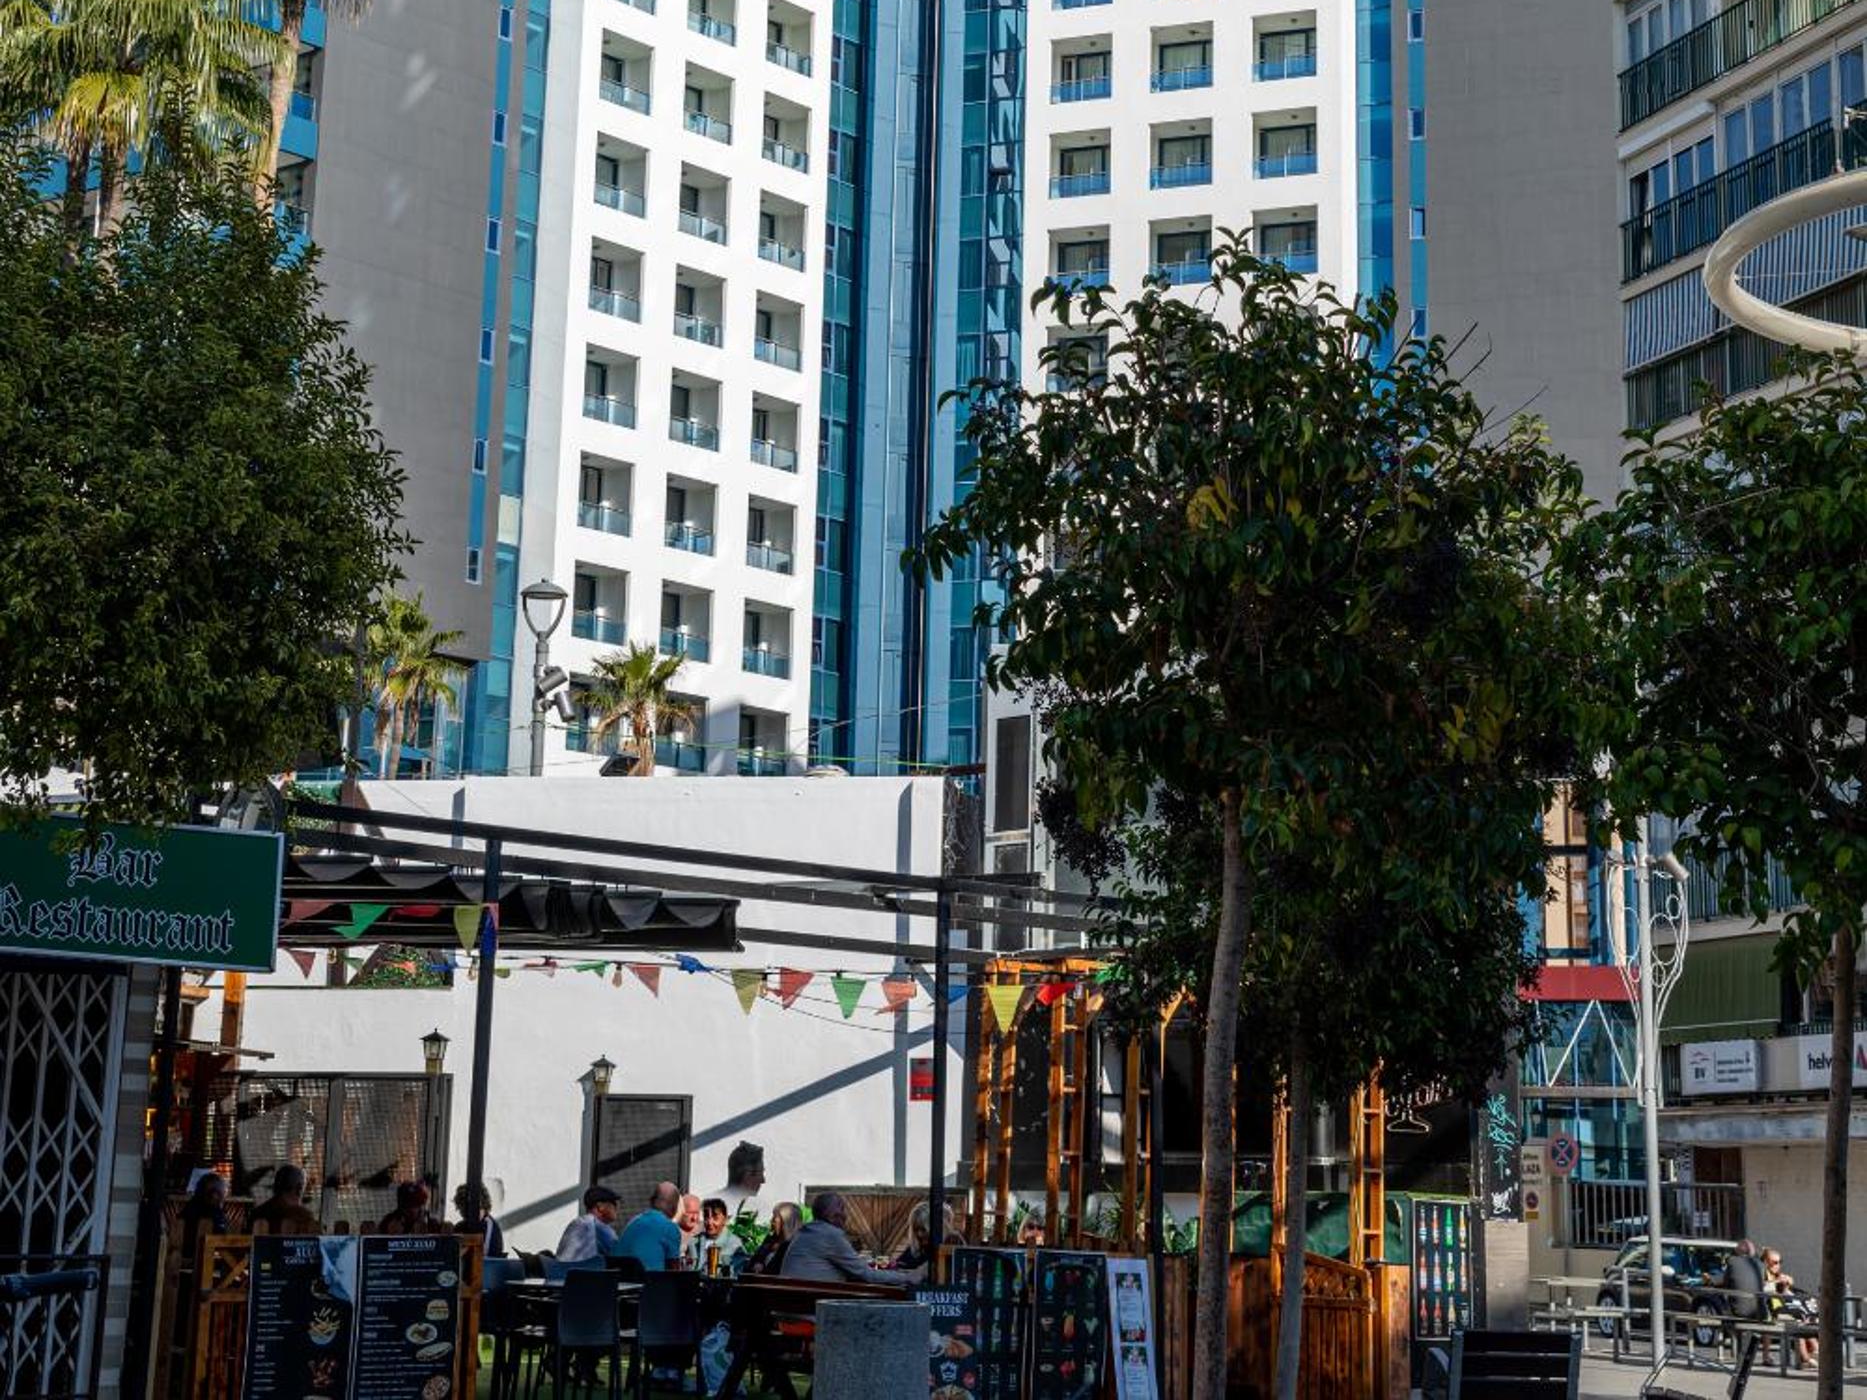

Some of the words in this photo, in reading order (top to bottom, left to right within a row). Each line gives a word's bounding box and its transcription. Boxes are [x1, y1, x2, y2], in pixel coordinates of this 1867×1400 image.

[66, 831, 163, 888] Bar
[0, 882, 236, 953] Restaurant
[1807, 1052, 1832, 1070] helv
[931, 1304, 962, 1317] FFERS
